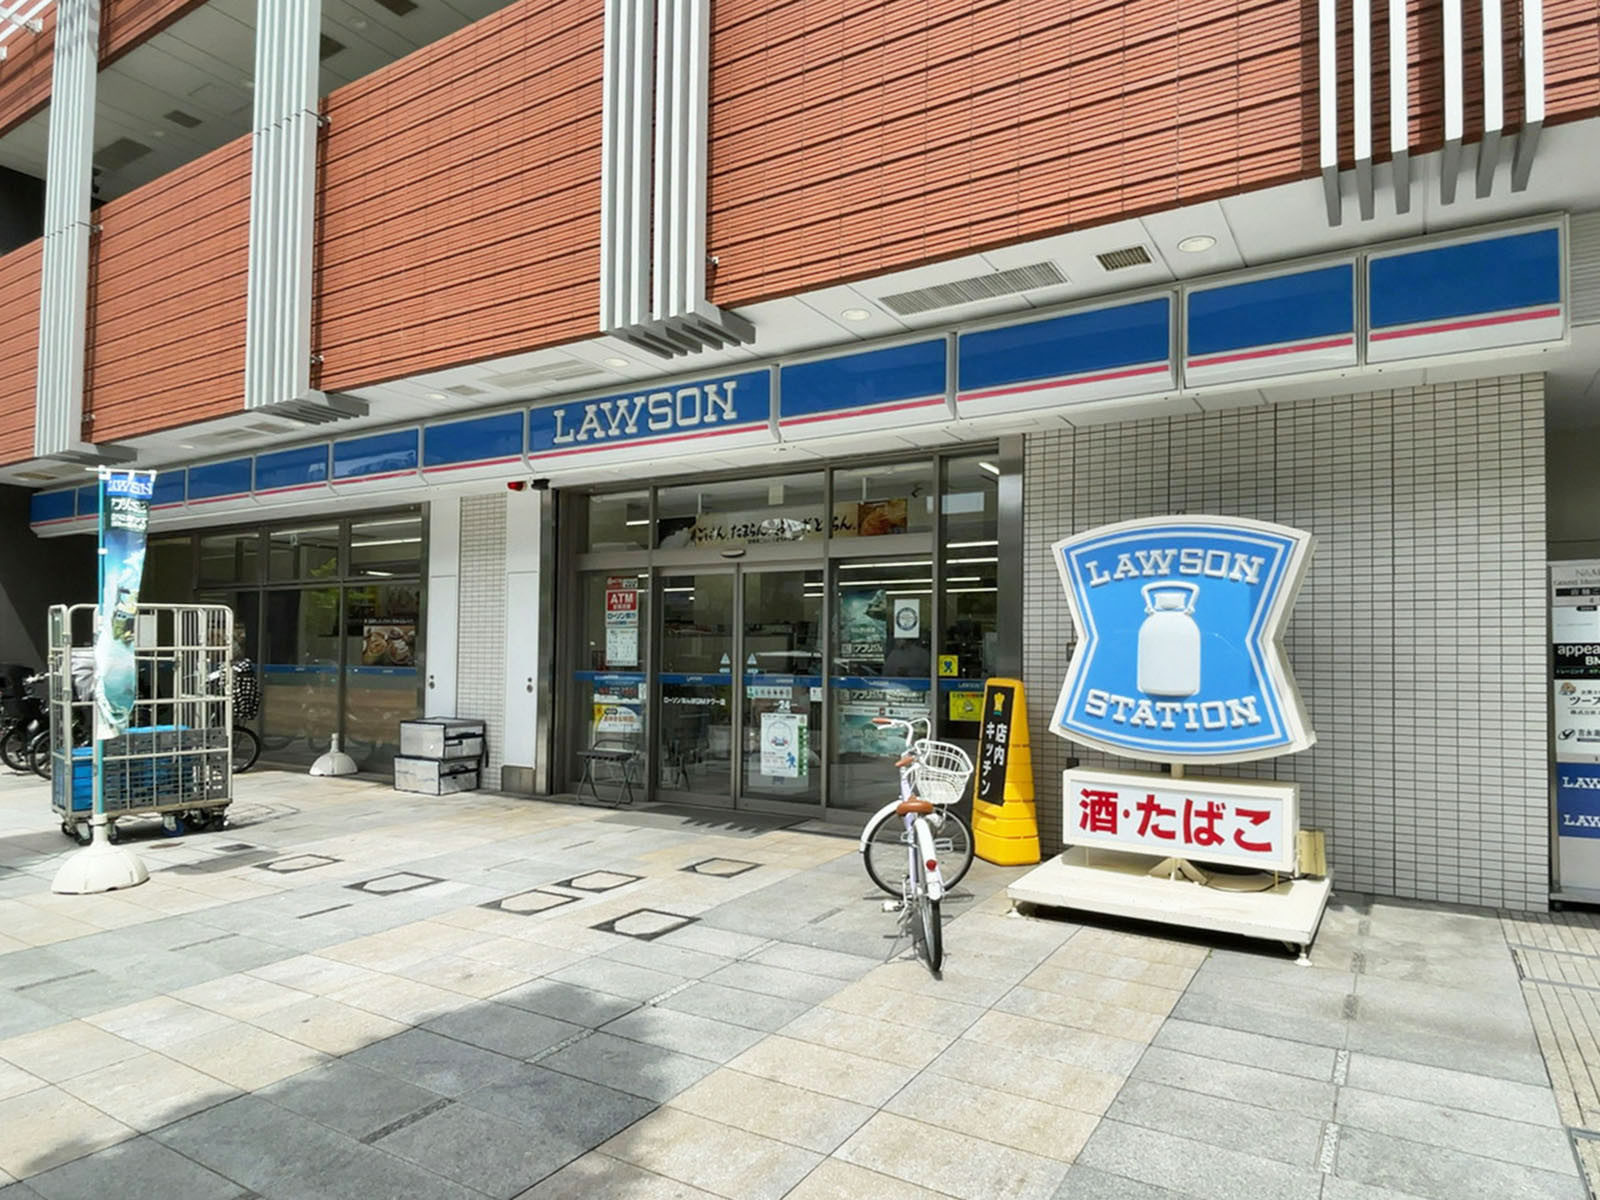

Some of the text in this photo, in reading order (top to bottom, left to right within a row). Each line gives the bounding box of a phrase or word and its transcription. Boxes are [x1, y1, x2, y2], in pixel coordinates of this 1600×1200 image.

[553, 381, 737, 444] LAWSON
[1085, 549, 1266, 588] LAWSON
[610, 593, 633, 604] ATM
[1557, 645, 1600, 657] appea
[1085, 688, 1262, 730] STATION
[981, 721, 995, 795] キッチン
[993, 723, 1008, 766] 店内
[1079, 787, 1274, 854] 酒・たばこ
